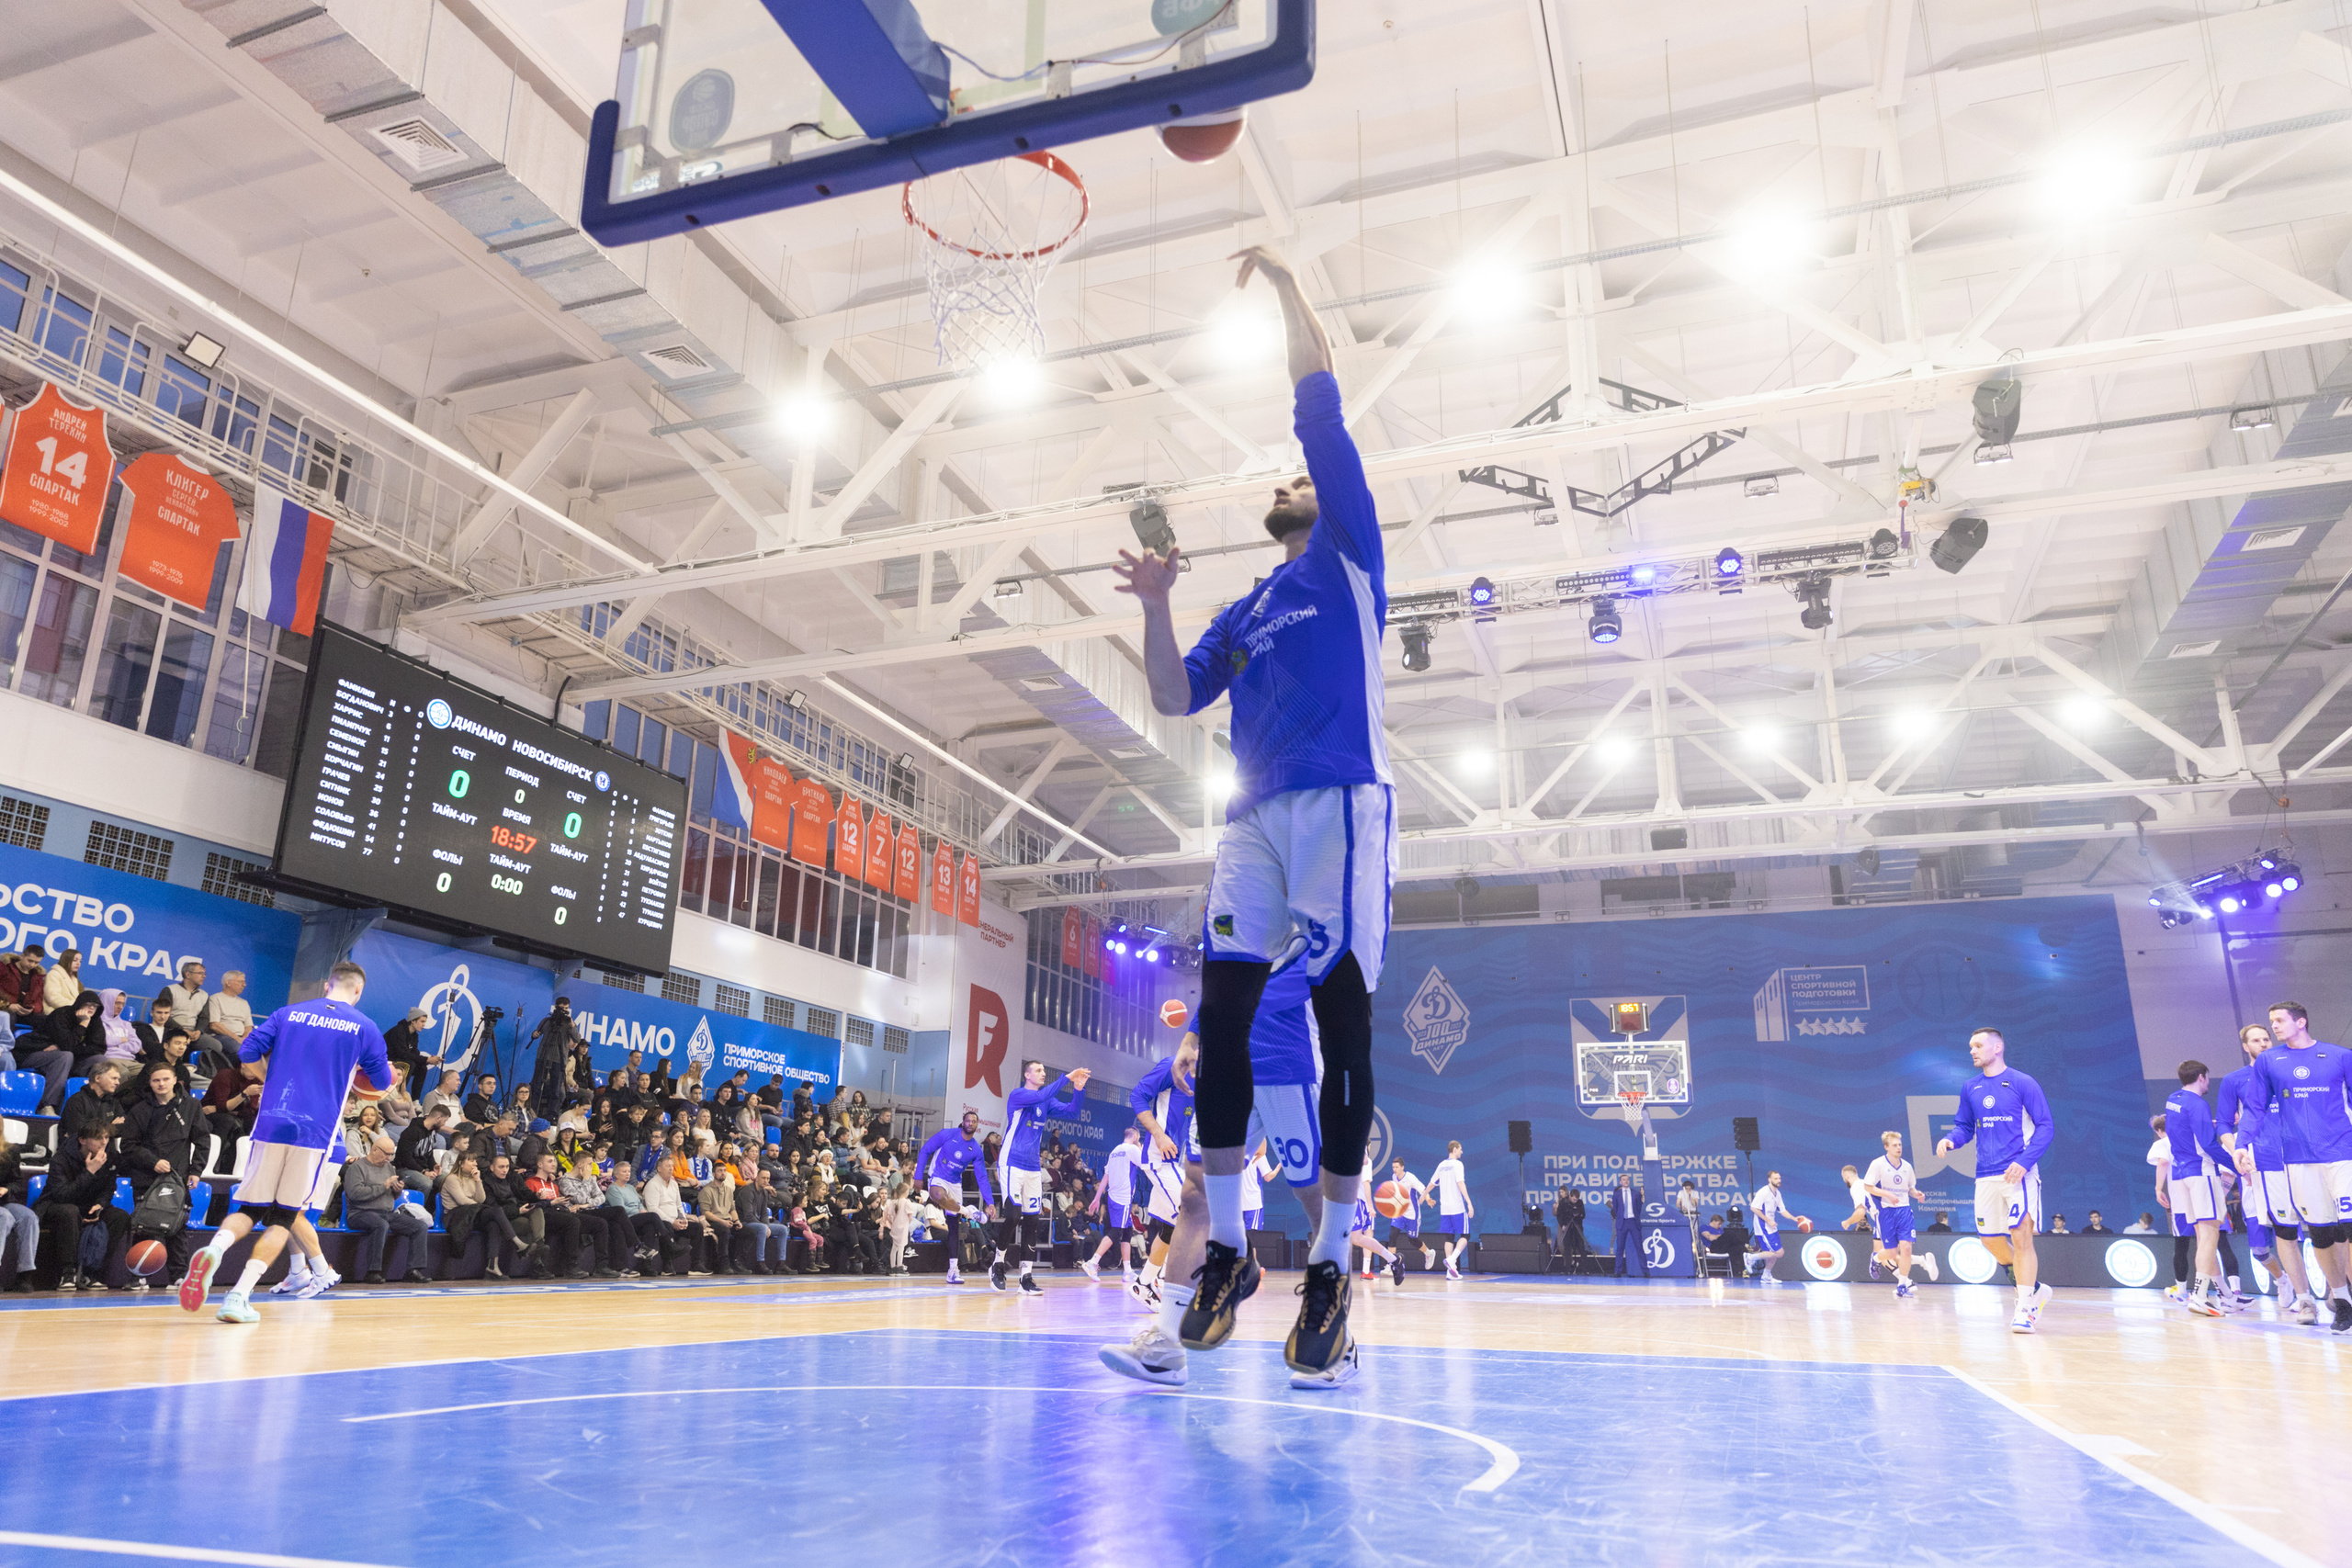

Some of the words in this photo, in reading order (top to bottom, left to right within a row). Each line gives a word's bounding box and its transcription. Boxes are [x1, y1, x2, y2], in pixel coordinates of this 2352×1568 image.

[53, 408, 87, 431] АНДРЕЙ
[36, 437, 88, 490] 14
[29, 473, 80, 506] СПАРТАК
[166, 469, 209, 500] КЛИГЕР
[173, 489, 197, 507] СЕРГЕЙ
[158, 505, 201, 536] СПАРТАК
[1245, 604, 1317, 649] ПРИМОРСКИЙ
[338, 679, 376, 699] ФАМИЛИЯ
[334, 702, 364, 719] ХАРРИС
[335, 690, 385, 714] БОГДАНОВИЧ
[331, 715, 372, 736] ПИЛИПЧУК
[384, 735, 390, 743] 11
[329, 728, 367, 748] СЕМЕНЮК
[381, 747, 390, 755] 15
[451, 716, 507, 746] ДИНАМО
[512, 739, 594, 782] НОВОСИБИРСК
[326, 740, 360, 758] СМЫГИН
[379, 760, 387, 768] 21
[452, 746, 476, 761] СЧЕТ
[324, 753, 364, 773] КОРЧАГИН
[375, 772, 386, 781] 24
[505, 766, 539, 788] ПЕРИОД
[322, 766, 351, 782] ГРАЧЕВ
[373, 784, 383, 793] 25
[448, 770, 470, 798] 0
[320, 780, 351, 795] СИТНИК
[371, 796, 381, 806] 30
[514, 789, 526, 804] 0
[566, 791, 587, 804] СЧЕТ
[317, 793, 345, 807] ИОНОВ
[368, 809, 379, 818] 36
[433, 803, 478, 826] ТАЙМ-АУТ
[503, 807, 532, 825] ВРЕМЯ
[315, 806, 355, 824] СОЛОВЬЕВ
[368, 822, 377, 830] 41
[564, 813, 582, 839] 0
[312, 819, 356, 838] ФЕДЮШИН
[365, 834, 375, 843] 54
[492, 826, 537, 854] 18:57
[842, 820, 858, 846] 12
[310, 832, 346, 849] МИТУСОВ
[362, 847, 373, 856] 77
[550, 843, 589, 863] ТАЙМ-АУТ
[876, 835, 886, 856] 7
[433, 849, 463, 865] ФОЛЫ
[490, 853, 532, 874] ТАЙМ-АУТ
[901, 848, 915, 872] 12
[436, 873, 452, 892] 0
[492, 874, 523, 895] 0:00
[939, 864, 951, 886] 13
[550, 886, 577, 900] ФОЛЫ
[965, 876, 977, 897] 14
[555, 907, 567, 925] 0
[981, 931, 1006, 949] ПАРТНЕР
[1070, 926, 1076, 942] 6
[1791, 974, 1822, 982] ЦЕНТР
[1792, 980, 1856, 989] СПОРТИВНОЙ
[1792, 990, 1856, 998] ПОДГОТОВКИ
[288, 1010, 361, 1035] БОГДАНОВИЧ
[551, 1005, 675, 1056] ИНАМО
[1427, 1021, 1451, 1039] 100
[1417, 1032, 1462, 1051] ДИНАМО
[724, 1043, 786, 1065] ПРИМОРСКОЕ
[1613, 1055, 1648, 1065] PARI
[723, 1055, 783, 1076] СПОРТИВНОЕ
[785, 1066, 830, 1085] ОБЩЕСТВО
[1045, 1119, 1082, 1137] ОРСКОГО
[1084, 1125, 1103, 1140] КРАЯ
[1544, 1156, 1587, 1169] ПРИ
[1593, 1156, 1737, 1171] ПОДЕРЖКЕ
[1545, 1173, 1739, 1187] ПРАВИТЕЬСТВА
